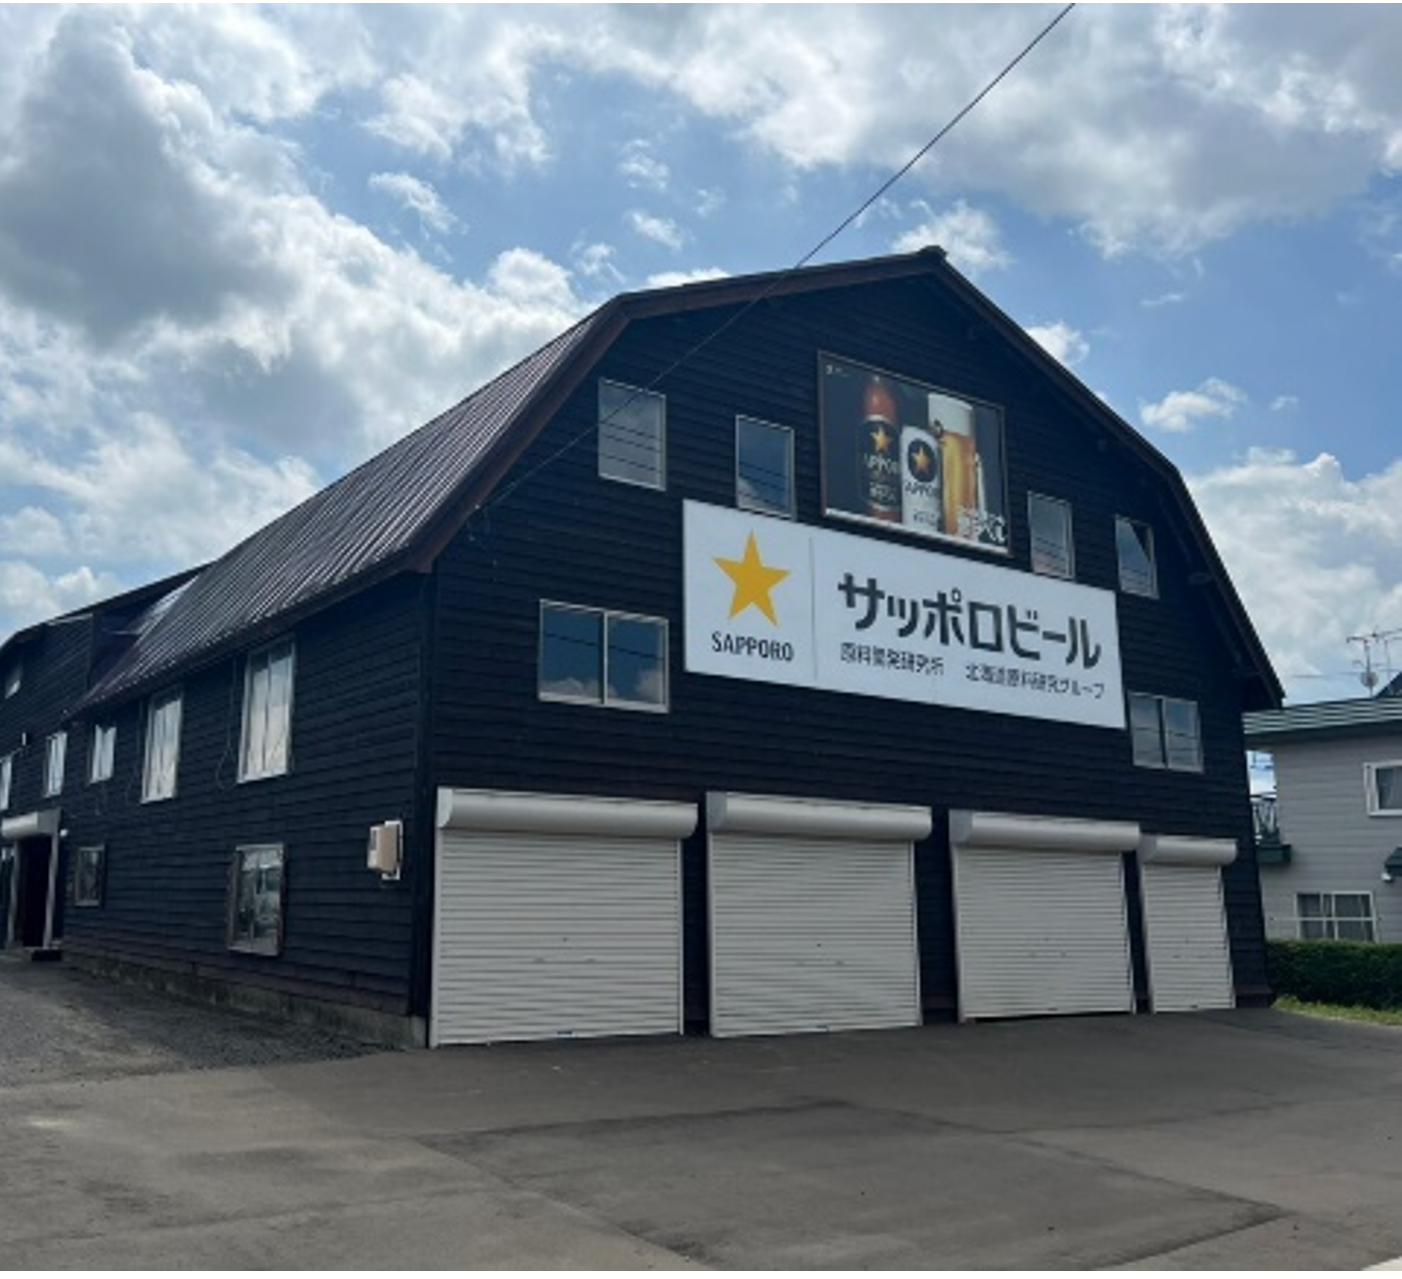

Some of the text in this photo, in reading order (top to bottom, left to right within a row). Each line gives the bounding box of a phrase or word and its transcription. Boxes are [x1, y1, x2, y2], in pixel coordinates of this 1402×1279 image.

[711, 630, 794, 662] SAPPORO
[838, 572, 1102, 670] サッポロビール
